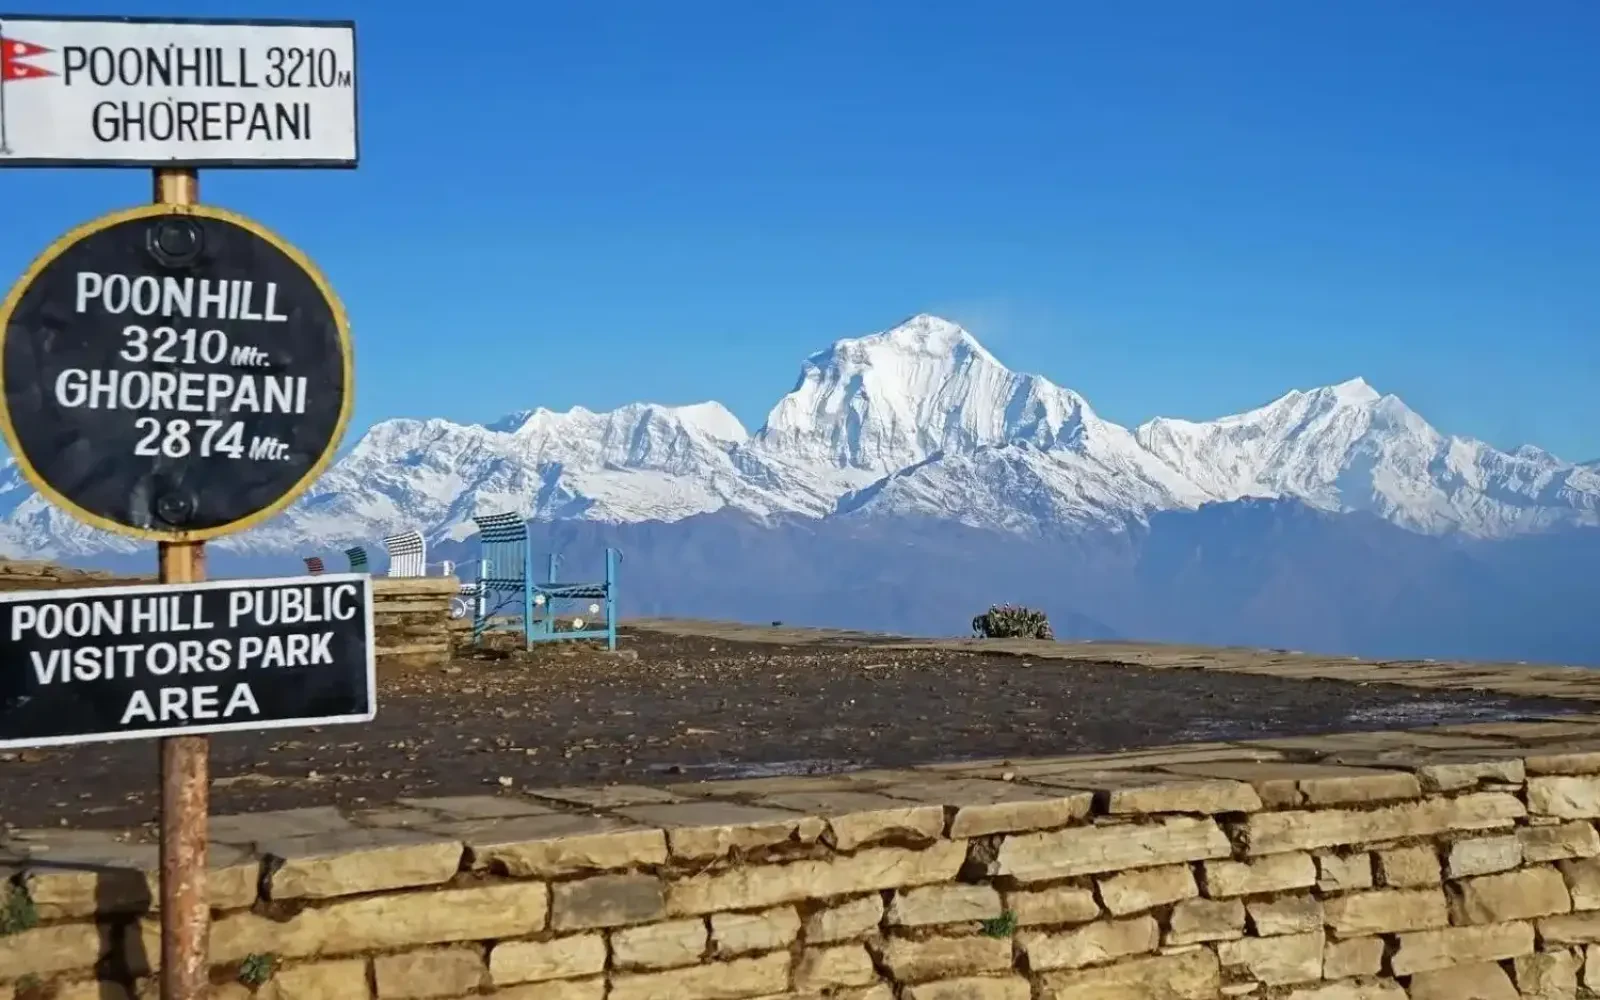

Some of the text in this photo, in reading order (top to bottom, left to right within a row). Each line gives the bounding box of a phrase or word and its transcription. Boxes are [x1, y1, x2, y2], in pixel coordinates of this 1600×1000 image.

[92, 101, 311, 142] GHOREPANI
[120, 325, 228, 364] 3210
[55, 368, 307, 414] GHOREPANI
[134, 417, 245, 459] 2874
[229, 584, 357, 628] PUBLIC
[30, 632, 335, 684] VISITORS PARK
[120, 682, 260, 724] AREA
